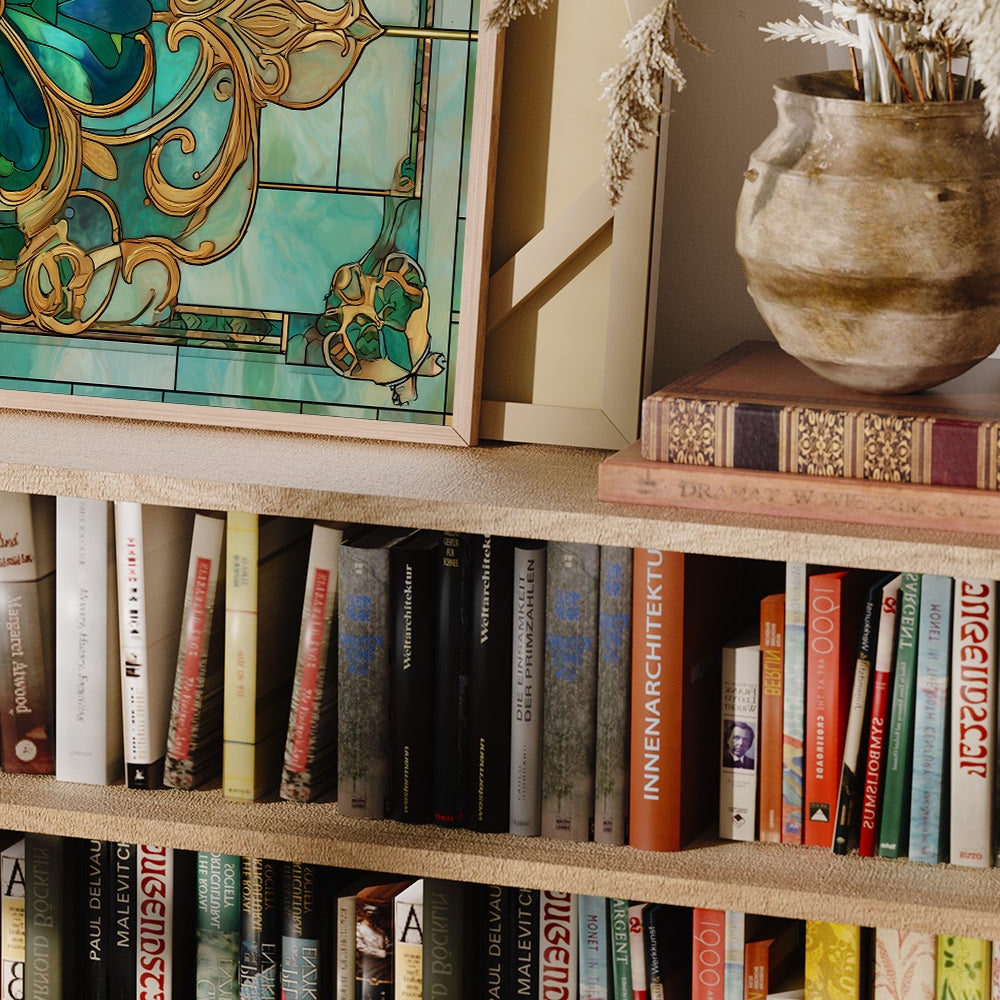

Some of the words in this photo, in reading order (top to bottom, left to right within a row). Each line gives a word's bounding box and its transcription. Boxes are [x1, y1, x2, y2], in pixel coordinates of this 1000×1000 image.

[6, 594, 25, 657] Margaret
[403, 564, 413, 670] Weltarchitektur
[516, 575, 526, 686] EINSAMKEIT
[525, 559, 535, 679] PRIMZAHLEN
[14, 660, 32, 714] Atwood
[516, 690, 525, 722] DIE
[524, 687, 533, 723] DER
[643, 549, 664, 801] INNENARCHITEKTU
[90, 840, 102, 916] DELVAU
[89, 920, 101, 962] PAUL
[588, 914, 598, 952] MONET
[651, 925, 660, 975] Werkkunst
[700, 921, 721, 988] 1900
